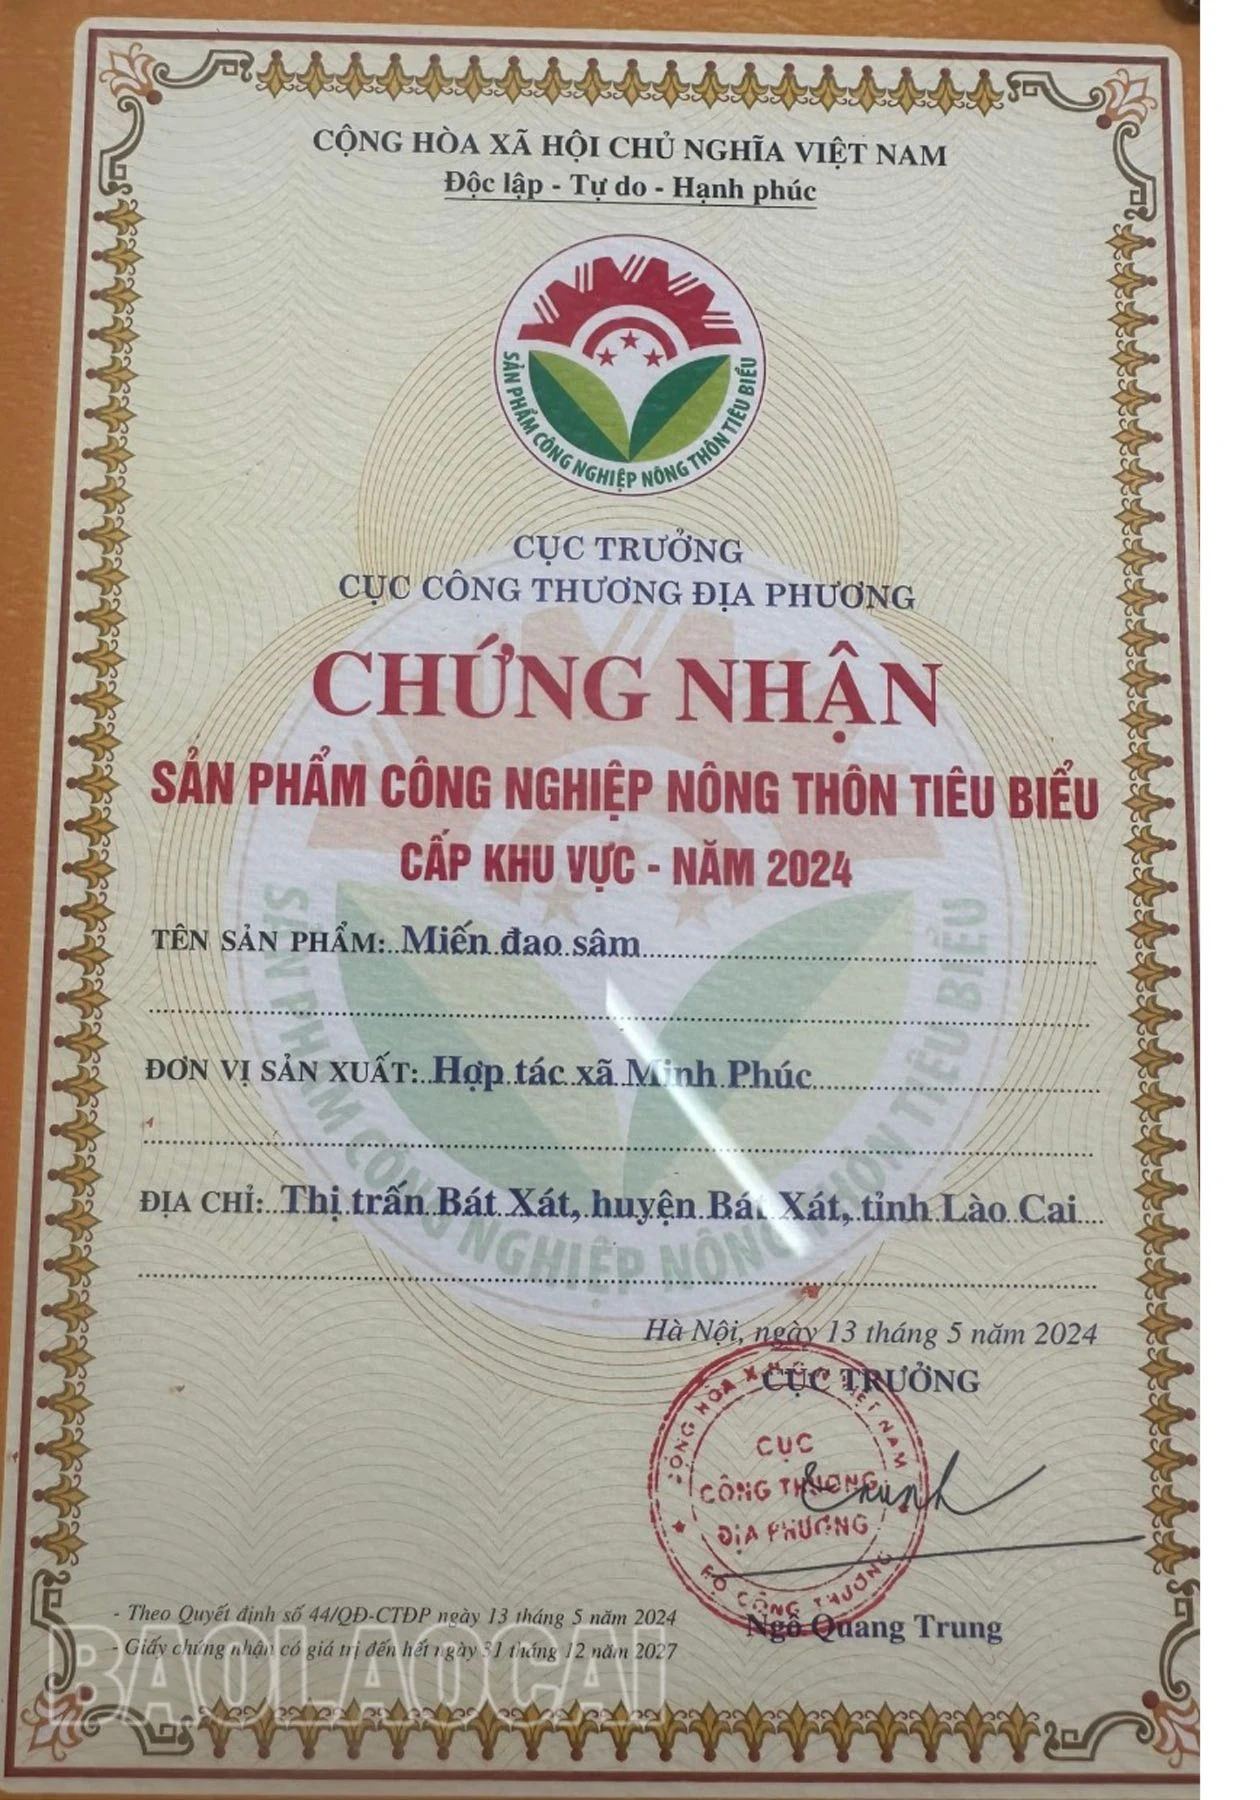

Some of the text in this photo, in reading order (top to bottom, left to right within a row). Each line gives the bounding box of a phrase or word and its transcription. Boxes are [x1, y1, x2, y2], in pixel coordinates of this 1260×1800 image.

[313, 124, 947, 170] CỘNG HÒA XÃ HỘI CHỦ NGHĨA VIỆT NAM
[444, 171, 816, 205] Độc lập Tự do Hạnh phúc
[503, 351, 757, 492] SẢN PHẨM CÔNG NGHIỆP NÔNG THÔN TIÊU BIỂU
[514, 529, 744, 567] CỤC TRƯỞNG
[339, 568, 916, 613] CỤC CÔNG THƯƠNG ĐỊA PHƯƠNG
[313, 632, 943, 742] CHỨNG NHẬN
[151, 745, 1099, 821] SẢN PHẨM CÔNG NGHIỆP NÔNG THÔN TIÊU BIỂU
[401, 829, 853, 892] CẤP KHU VỰC NĂM 2024
[152, 924, 209, 953] TÊN
[222, 924, 278, 953] SẢN
[402, 921, 488, 956] Miến
[500, 924, 562, 956] đao
[573, 927, 640, 957] sâm
[145, 1051, 812, 1092] ĐƠN VỊ SẢN XUẤT: Hợp tác xã Minh Phúc
[139, 1190, 192, 1219] ĐỊA
[201, 1184, 264, 1214] CHỈ:
[281, 1184, 340, 1222] Thị
[352, 1180, 425, 1216] trấn
[438, 1186, 497, 1217] Bát
[509, 1187, 582, 1223] Xát,
[591, 1189, 696, 1227] huyện
[780, 1191, 850, 1226] Xát,
[862, 1192, 929, 1223] tỉnh
[941, 1193, 1007, 1223] Lào
[1020, 1194, 1077, 1224] Cai
[644, 1318, 1098, 1351] Hà Nội, ngày 13 tháng 5 năm 2024
[762, 1368, 833, 1399] CỤC
[842, 1362, 980, 1393] TRƯỞNG
[757, 1432, 814, 1463] CỤC
[700, 1473, 771, 1504] CÔNG
[129, 1604, 677, 1628] Theo Quyết định số 44/QĐ-CTĐP ngày 13 tháng 5 năm 2024
[746, 1612, 1003, 1644] Ngô Quang Trung
[125, 1637, 167, 1659] Giấy
[280, 1640, 301, 1656] có
[306, 1640, 334, 1660] giá
[340, 1643, 358, 1659] trị
[365, 1640, 397, 1657] đến
[402, 1640, 427, 1657] hết
[565, 1642, 585, 1658] 12
[592, 1644, 629, 1659] năm
[635, 1643, 678, 1660] 2027
